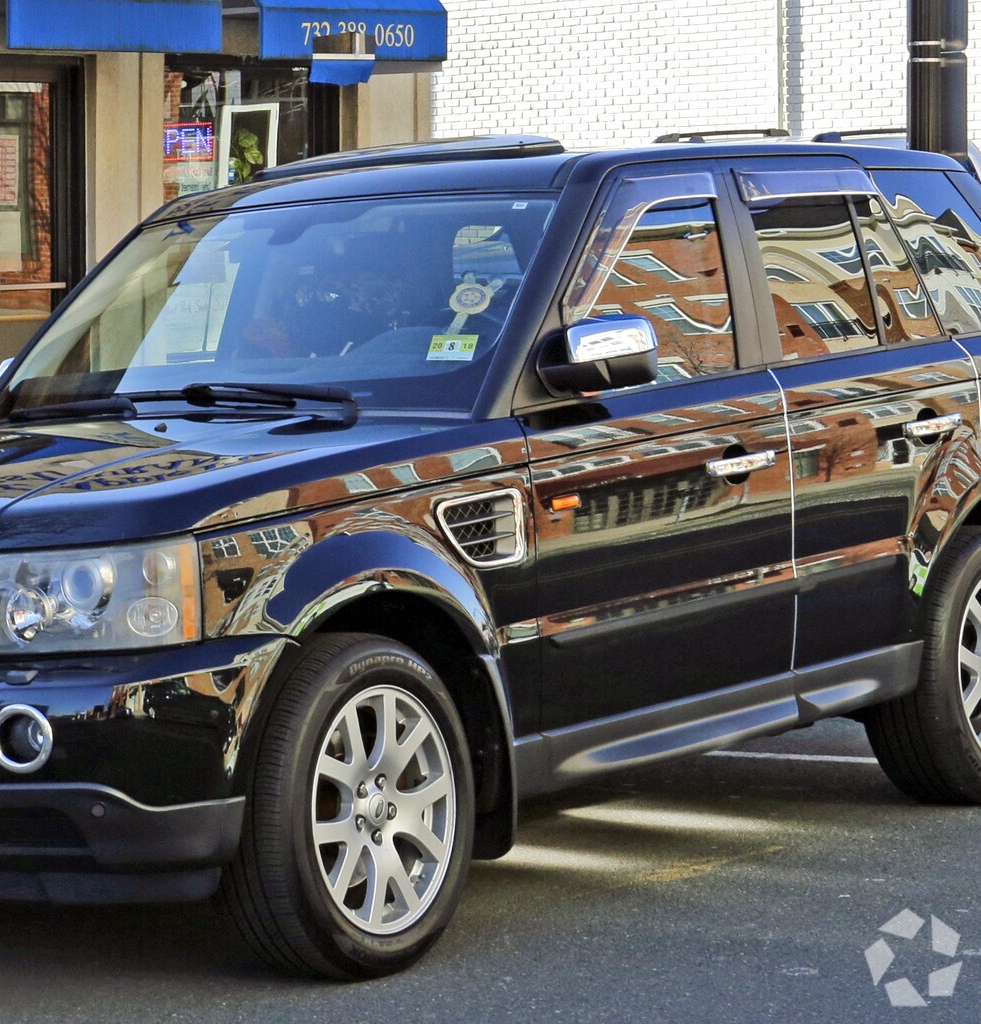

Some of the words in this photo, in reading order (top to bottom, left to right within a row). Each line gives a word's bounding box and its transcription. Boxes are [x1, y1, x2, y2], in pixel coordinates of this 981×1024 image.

[374, 23, 415, 47] 0650
[163, 127, 211, 155] PEN
[448, 341, 456, 351] 8
[349, 655, 405, 675] Dynapro
